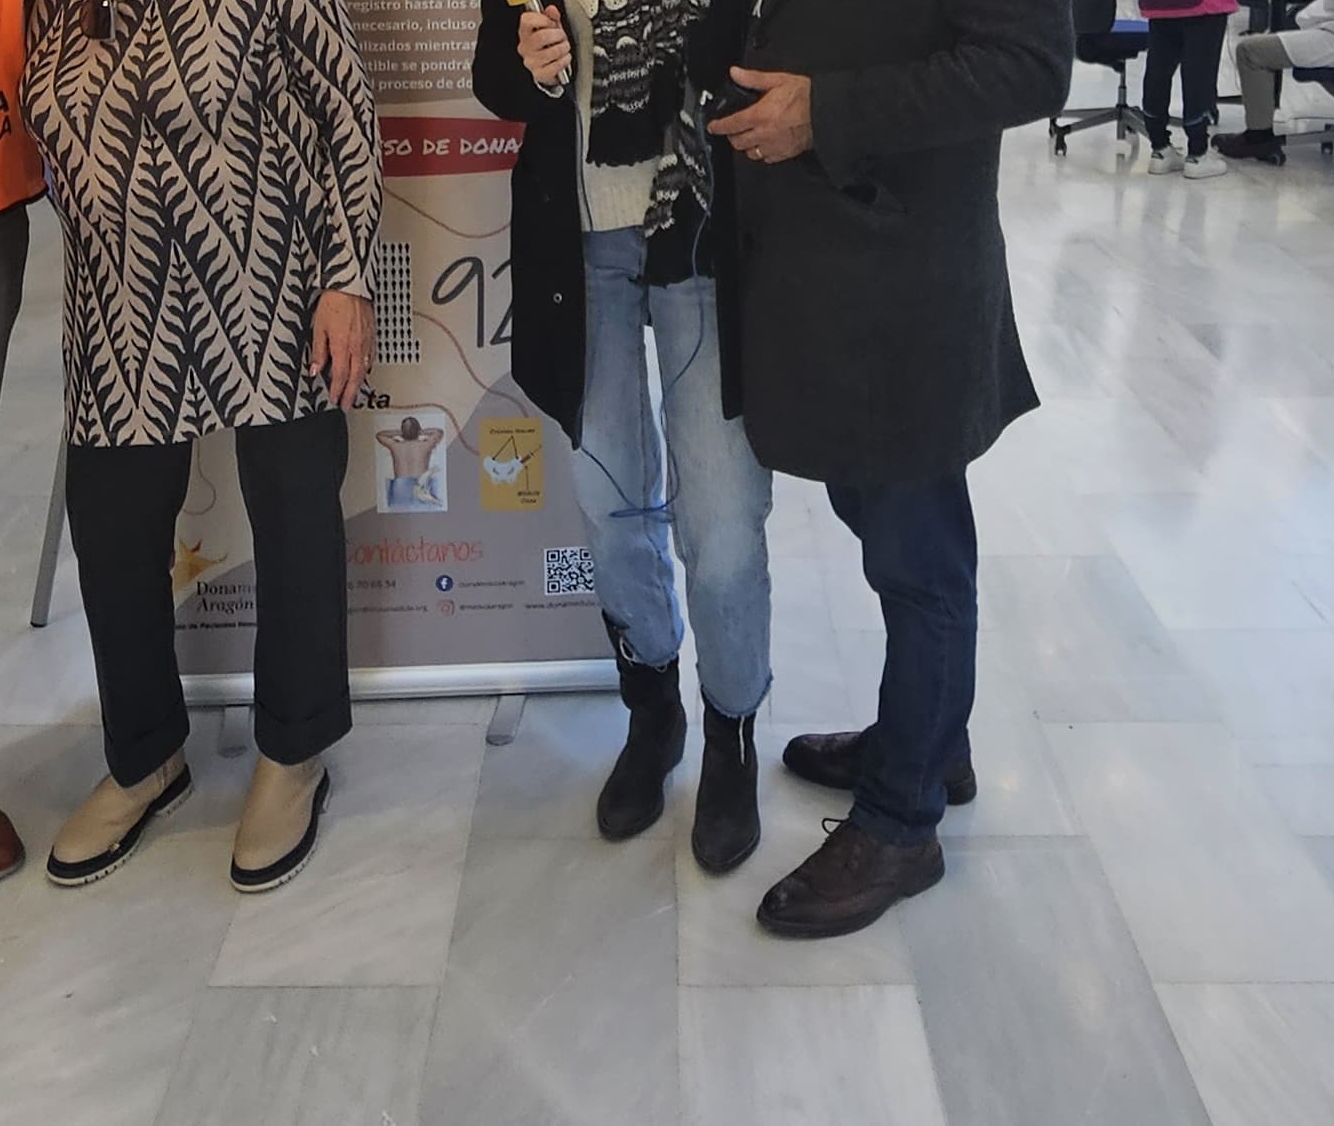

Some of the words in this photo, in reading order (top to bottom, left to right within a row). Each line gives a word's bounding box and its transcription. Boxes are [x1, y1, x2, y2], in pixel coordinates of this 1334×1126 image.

[353, 20, 423, 32] necesario,
[427, 18, 476, 30] incluso
[359, 39, 411, 52] lizados
[365, 59, 398, 72] tible
[402, 62, 418, 72] se
[379, 79, 433, 91] proceso
[436, 77, 454, 89] de
[381, 138, 413, 156] SO
[422, 138, 451, 155] DE
[460, 137, 523, 155] DONA
[196, 598, 255, 615] Aragón
